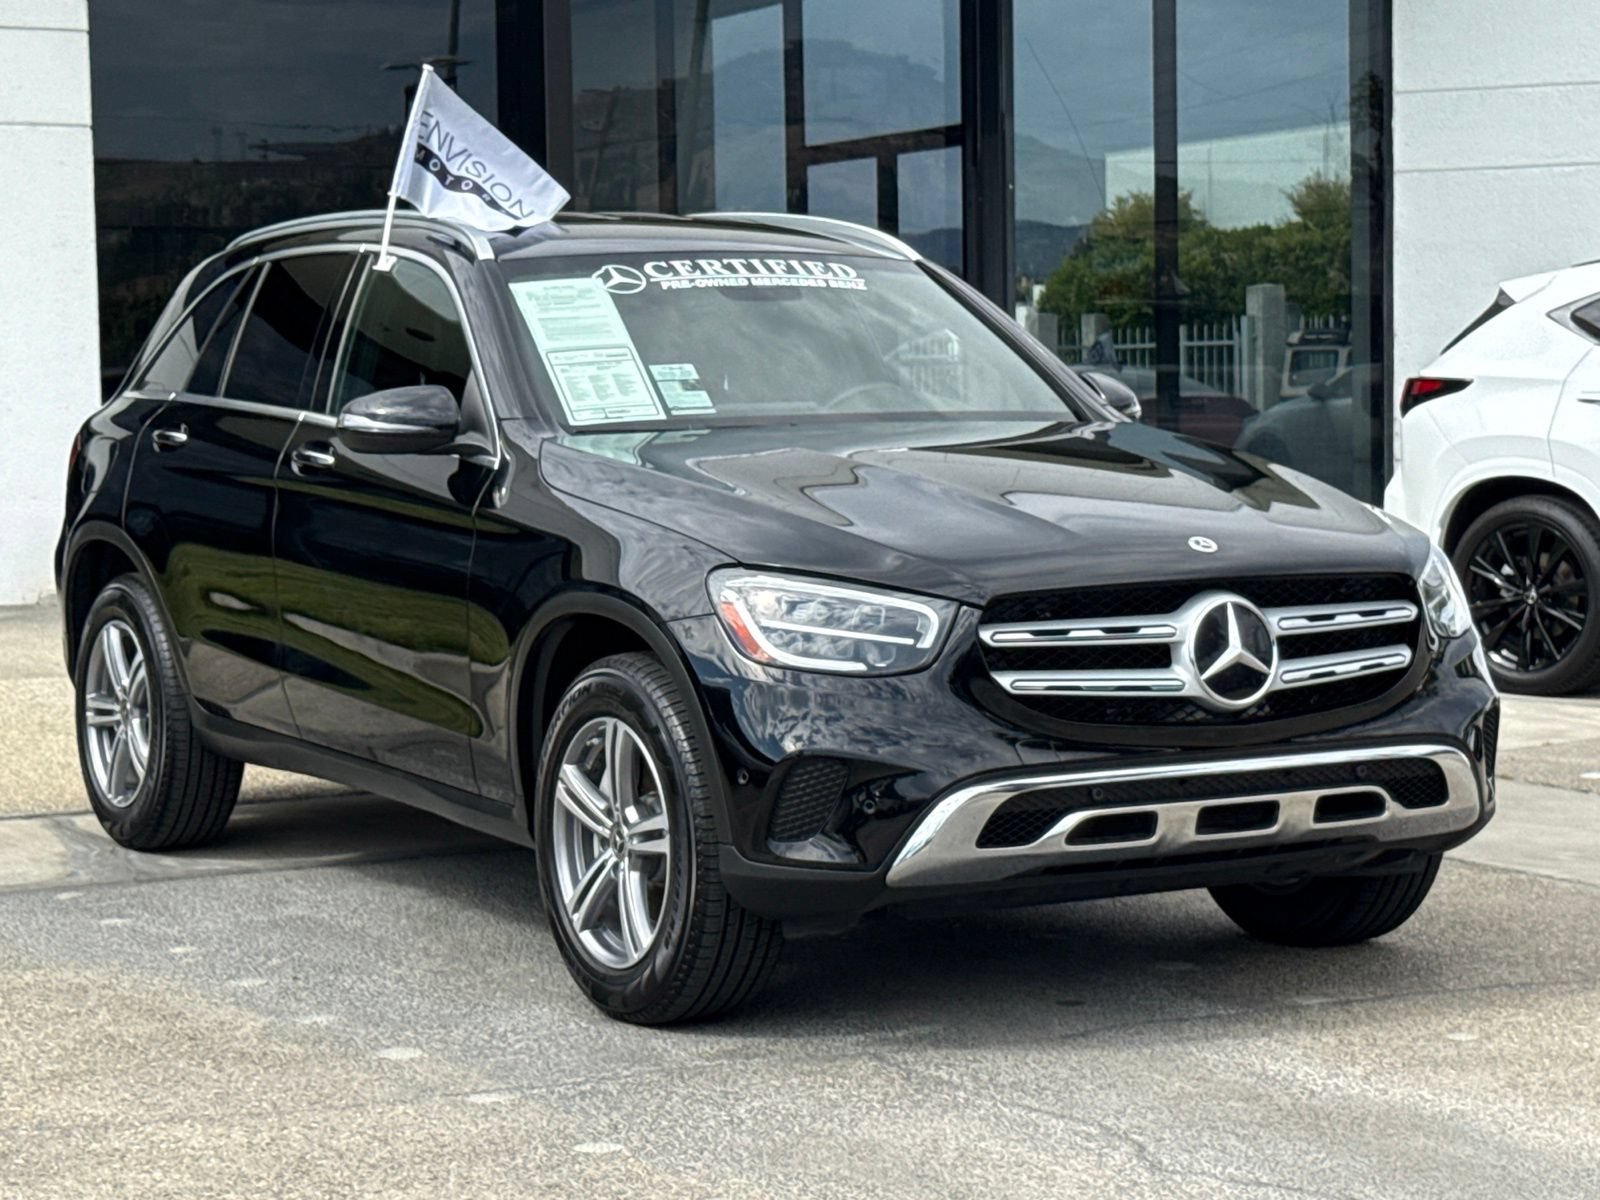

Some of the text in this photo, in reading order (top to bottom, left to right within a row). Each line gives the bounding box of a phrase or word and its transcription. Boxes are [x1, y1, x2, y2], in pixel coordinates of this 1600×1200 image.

[417, 110, 534, 218] ENVISION
[643, 259, 857, 279] CERTIFIED
[661, 277, 867, 291] PRE-OWNED MERCEDES BENZ
